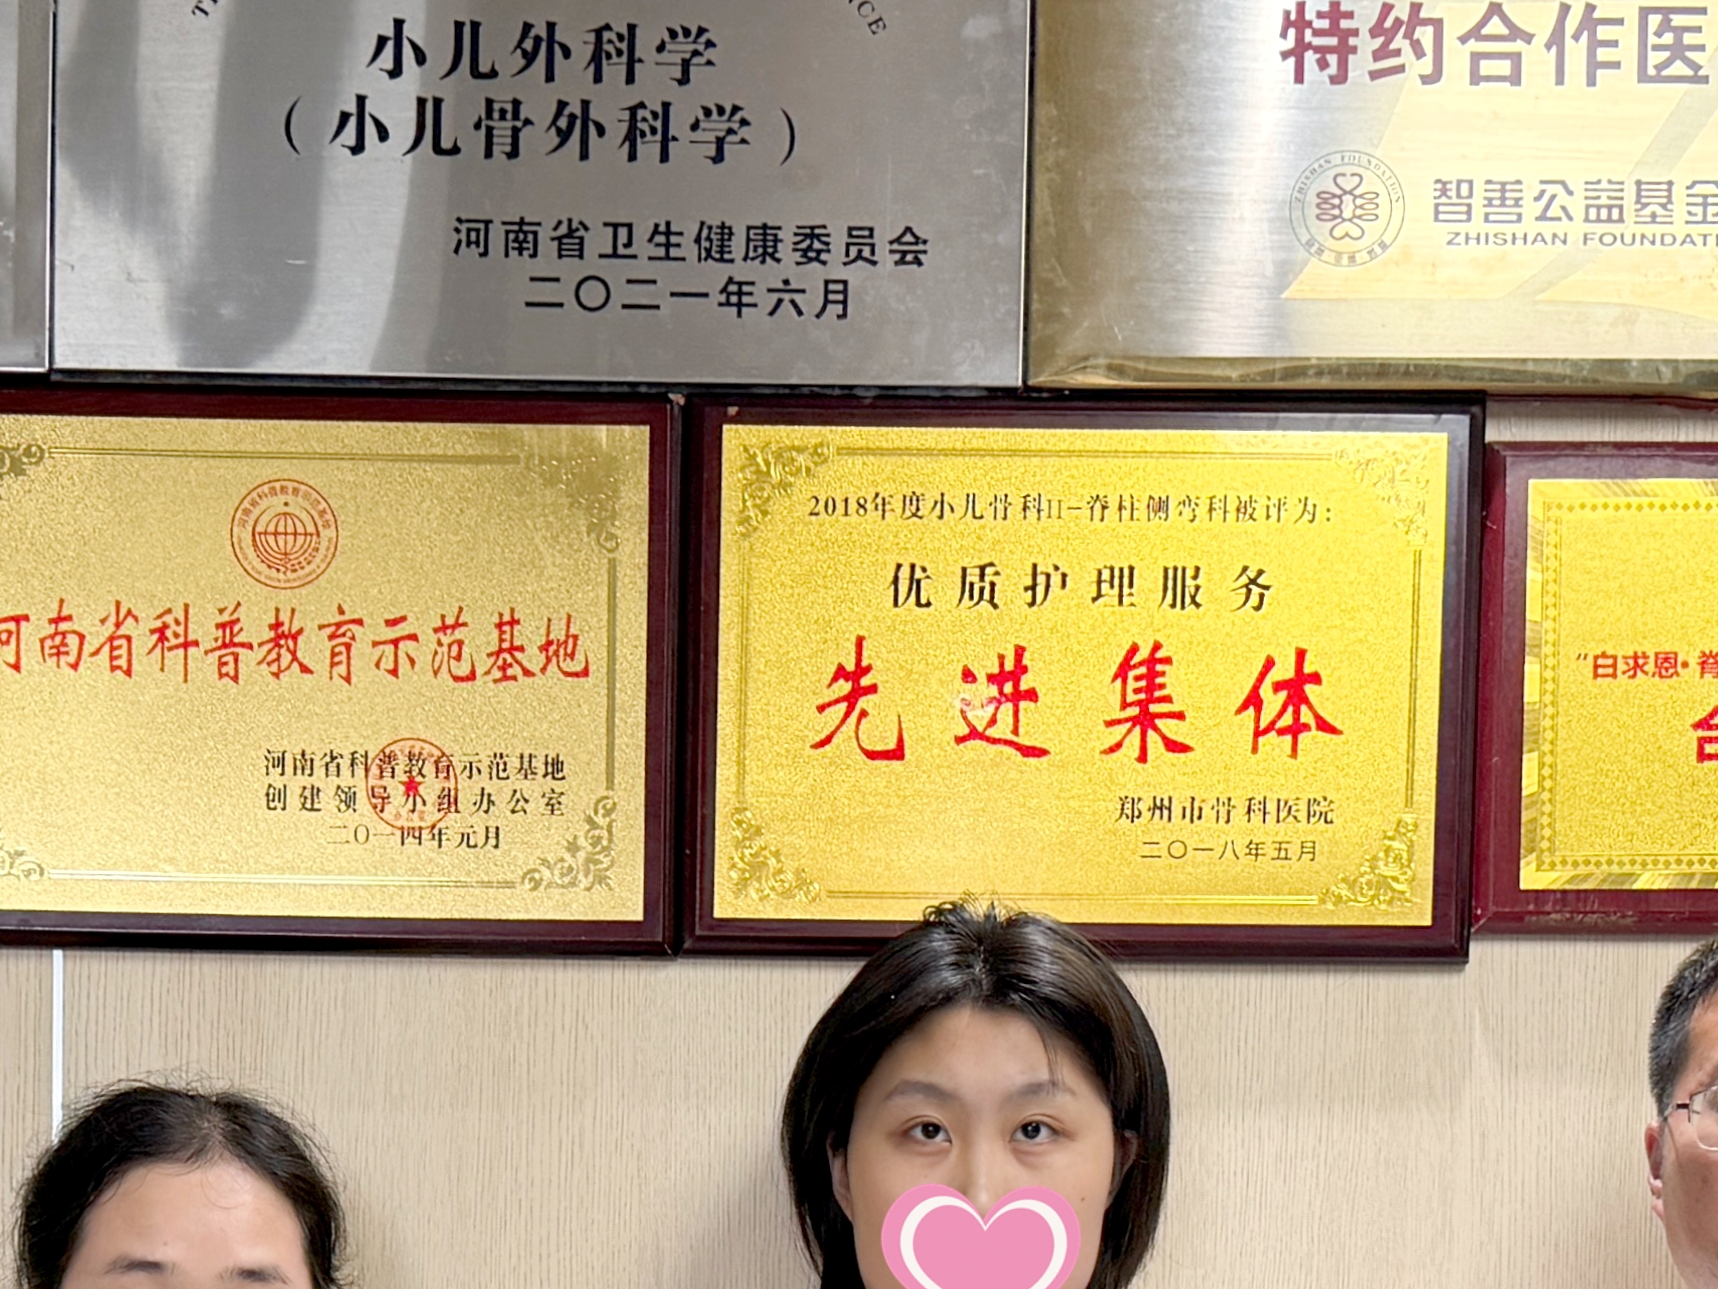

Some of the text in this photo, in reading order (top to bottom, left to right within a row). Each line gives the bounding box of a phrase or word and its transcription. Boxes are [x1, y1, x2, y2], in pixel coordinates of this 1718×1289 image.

[366, 18, 719, 88] 小儿外科学
[283, 95, 798, 167] （小儿骨外科学）
[452, 215, 932, 269] 河南省卫生健康委员会
[1445, 231, 1570, 248] ZHISHAN
[523, 274, 853, 321] 二〇二一年六月
[888, 563, 1273, 612] 优质护理服务
[810, 634, 1344, 764] 先进集体
[264, 749, 567, 781] 河南省科普教育示范基地
[265, 783, 567, 816] 创建领导小组办公室
[1115, 795, 1335, 825] 郑州市骨科医院
